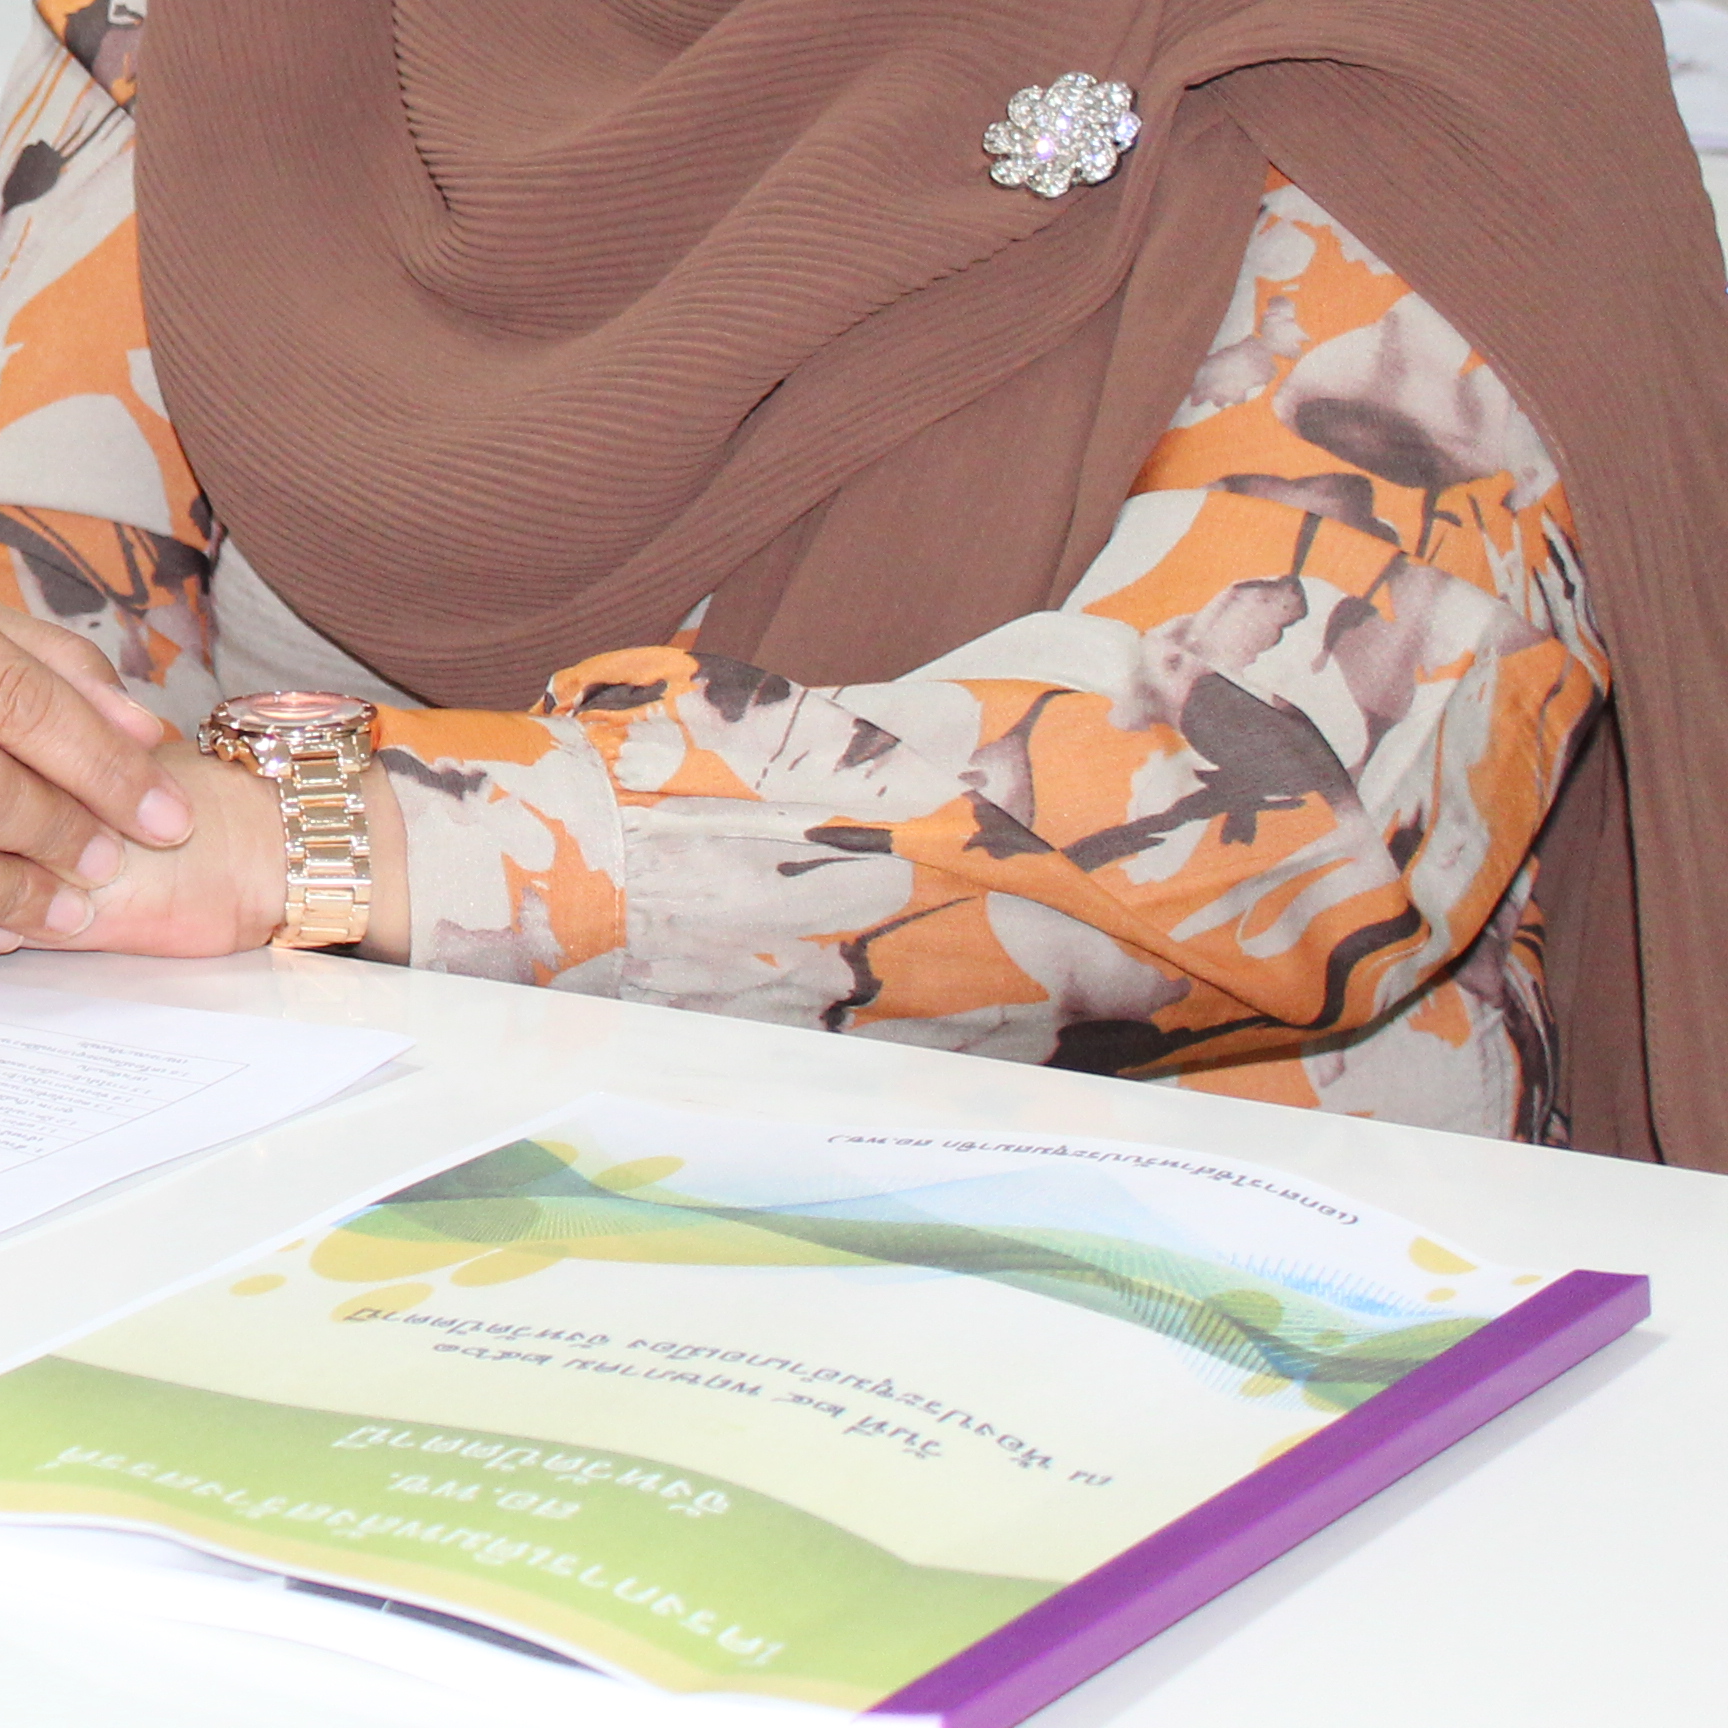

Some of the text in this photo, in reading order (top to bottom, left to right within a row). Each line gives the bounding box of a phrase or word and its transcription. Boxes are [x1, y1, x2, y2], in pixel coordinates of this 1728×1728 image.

[343, 1308, 610, 1349] จังหวัดปัตตานี
[563, 1356, 763, 1398] พฤษภาคม
[841, 1415, 943, 1460] วันที่
[331, 1422, 731, 1518] จังหวัดปัตตานี
